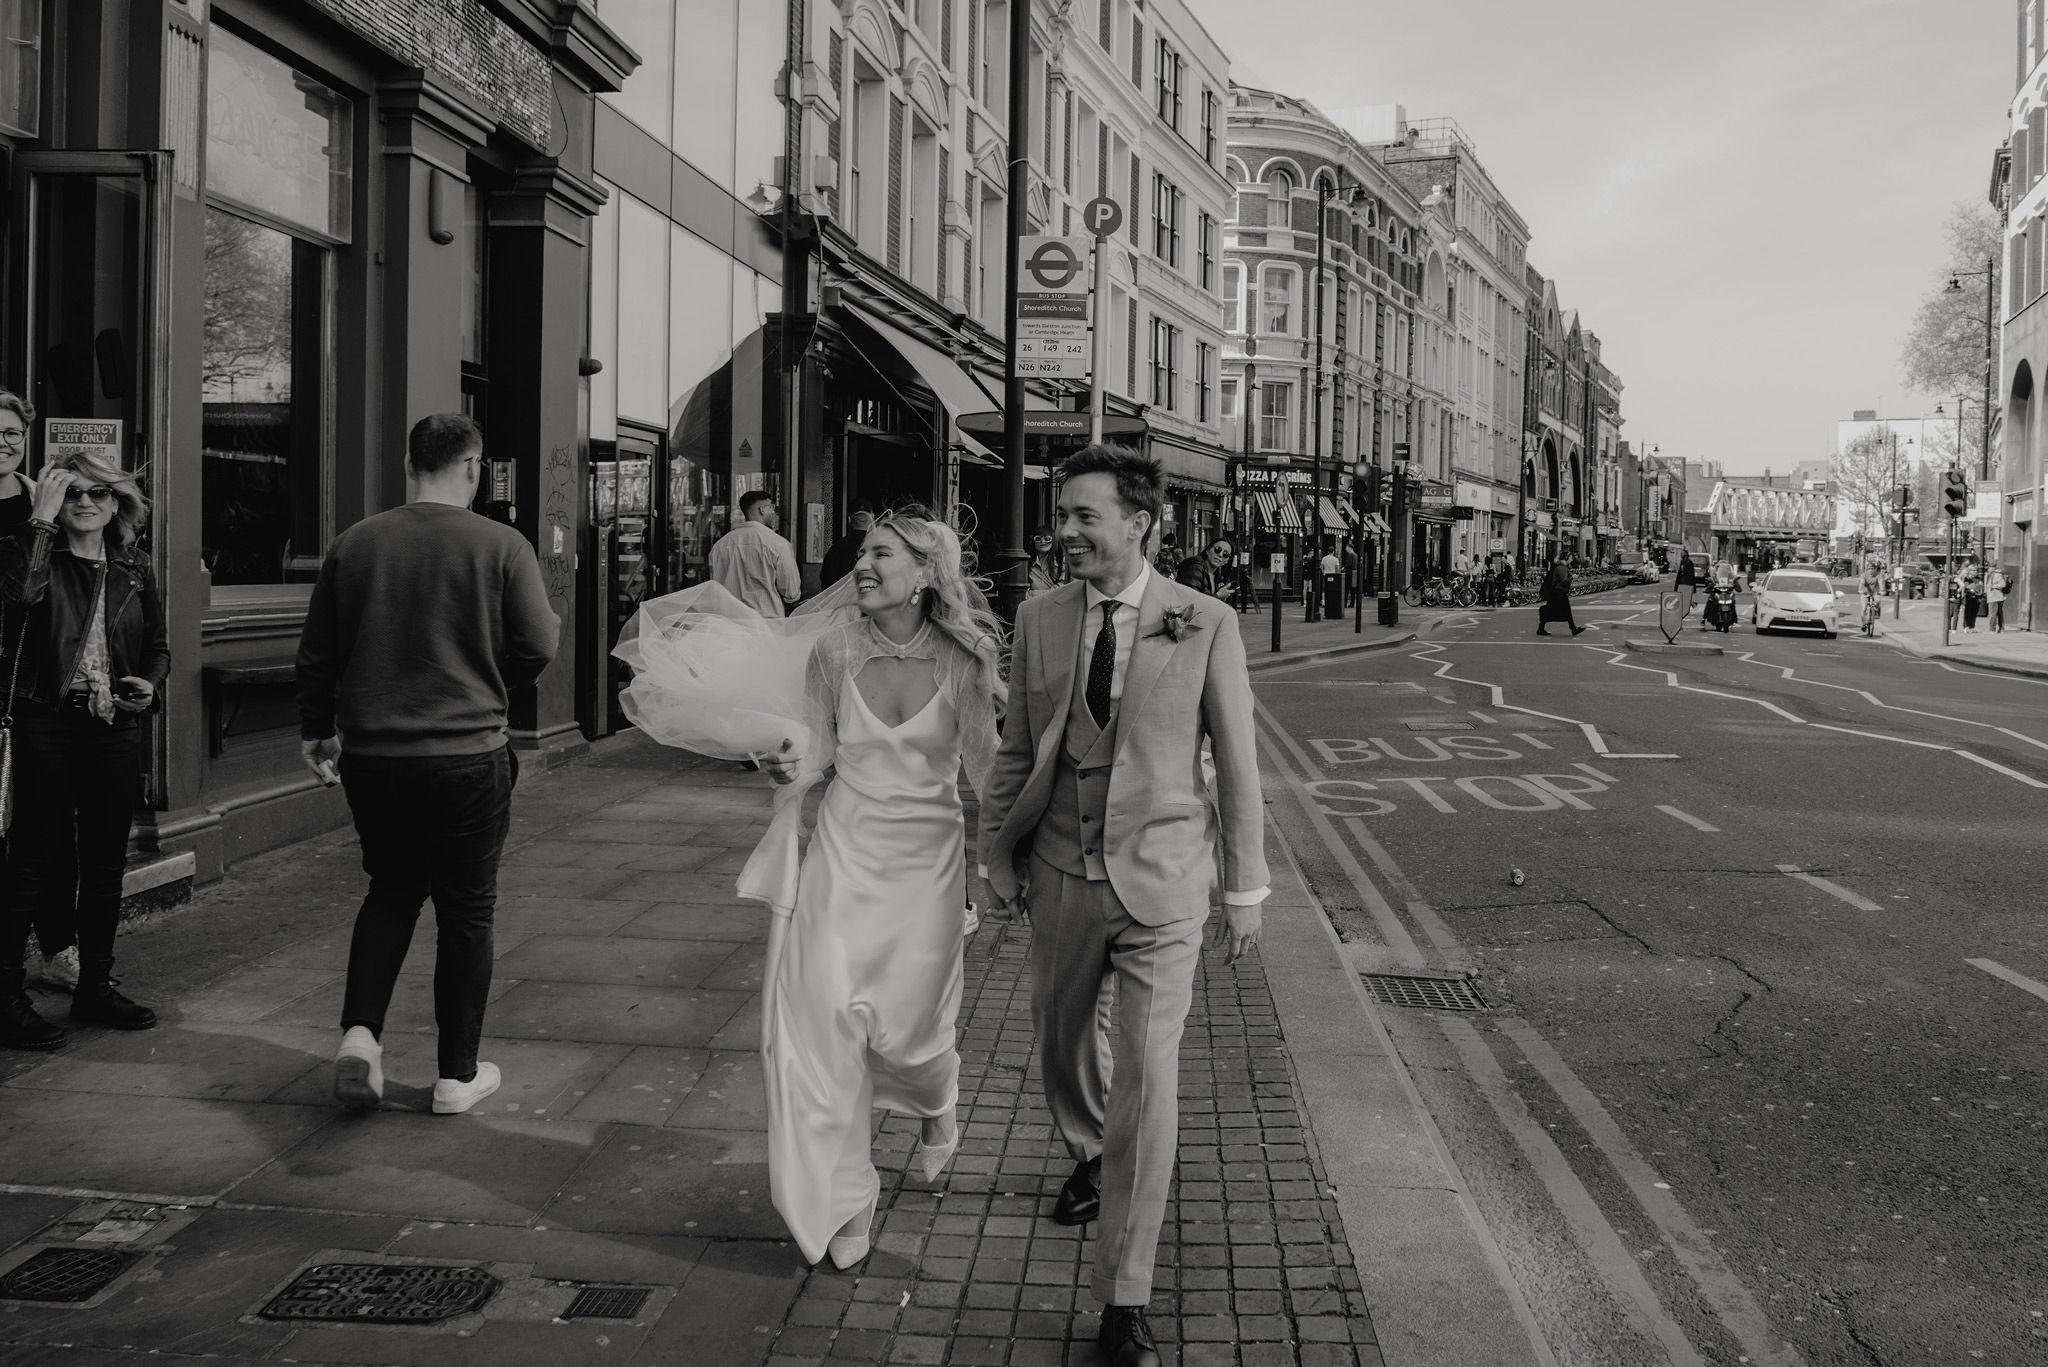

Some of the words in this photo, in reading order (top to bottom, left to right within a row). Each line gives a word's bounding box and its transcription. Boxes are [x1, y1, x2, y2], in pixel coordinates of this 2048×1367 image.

[1095, 203, 1114, 229] P
[1022, 343, 1033, 352] 26
[1043, 344, 1058, 352] 149
[1066, 345, 1082, 353] 242
[1018, 363, 1035, 371] N26
[1039, 364, 1061, 372] N242
[51, 423, 116, 434] EMERGENCY
[1058, 420, 1083, 428] Church
[57, 433, 80, 443] EXIT
[81, 433, 108, 443] ONLY
[1306, 736, 1523, 764] BUS
[1303, 774, 1610, 817] STOP
